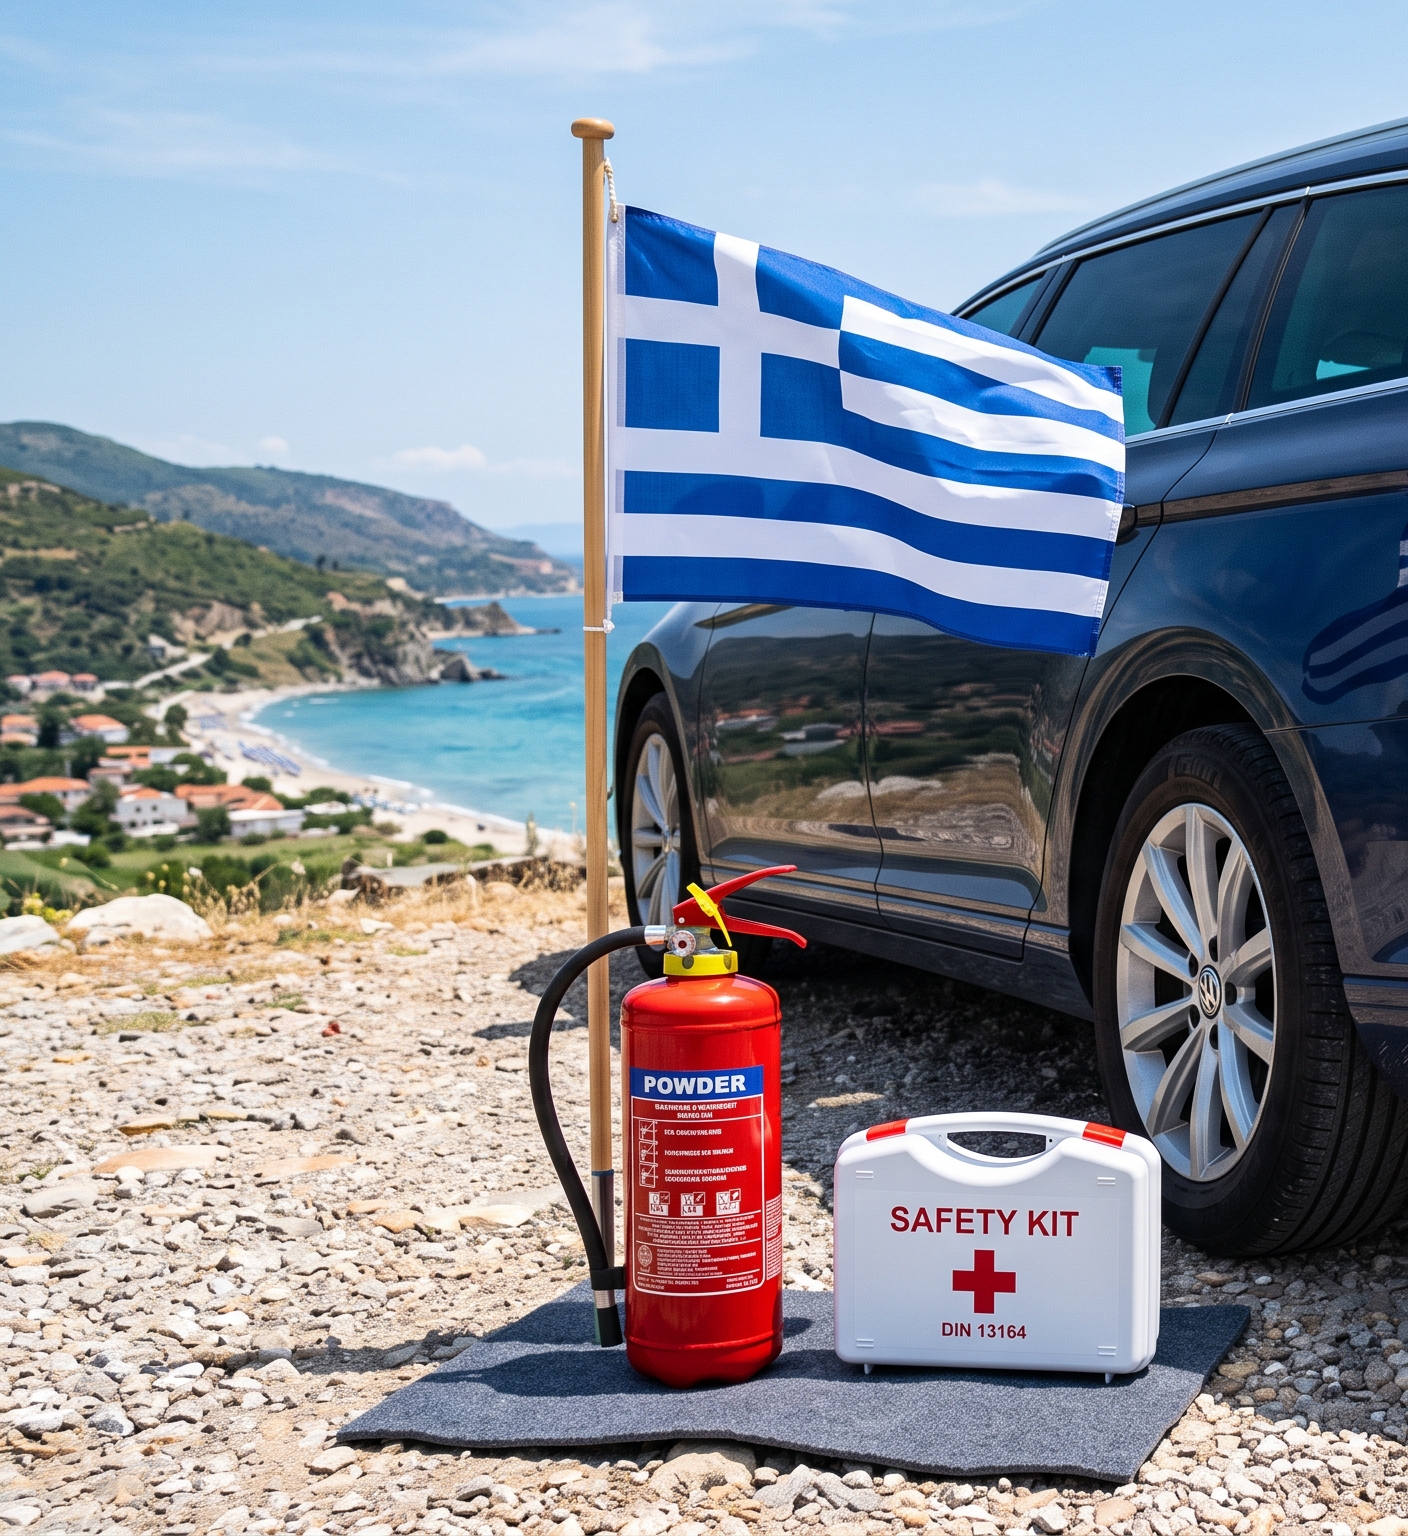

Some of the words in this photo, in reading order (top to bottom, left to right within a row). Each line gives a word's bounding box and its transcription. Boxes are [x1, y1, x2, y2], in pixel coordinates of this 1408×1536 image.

[644, 1074, 746, 1095] POWDER
[890, 1205, 1018, 1235] SAFETY
[1028, 1210, 1080, 1237] KIT
[941, 1322, 971, 1338] DIN
[977, 1323, 1027, 1340] 13164
